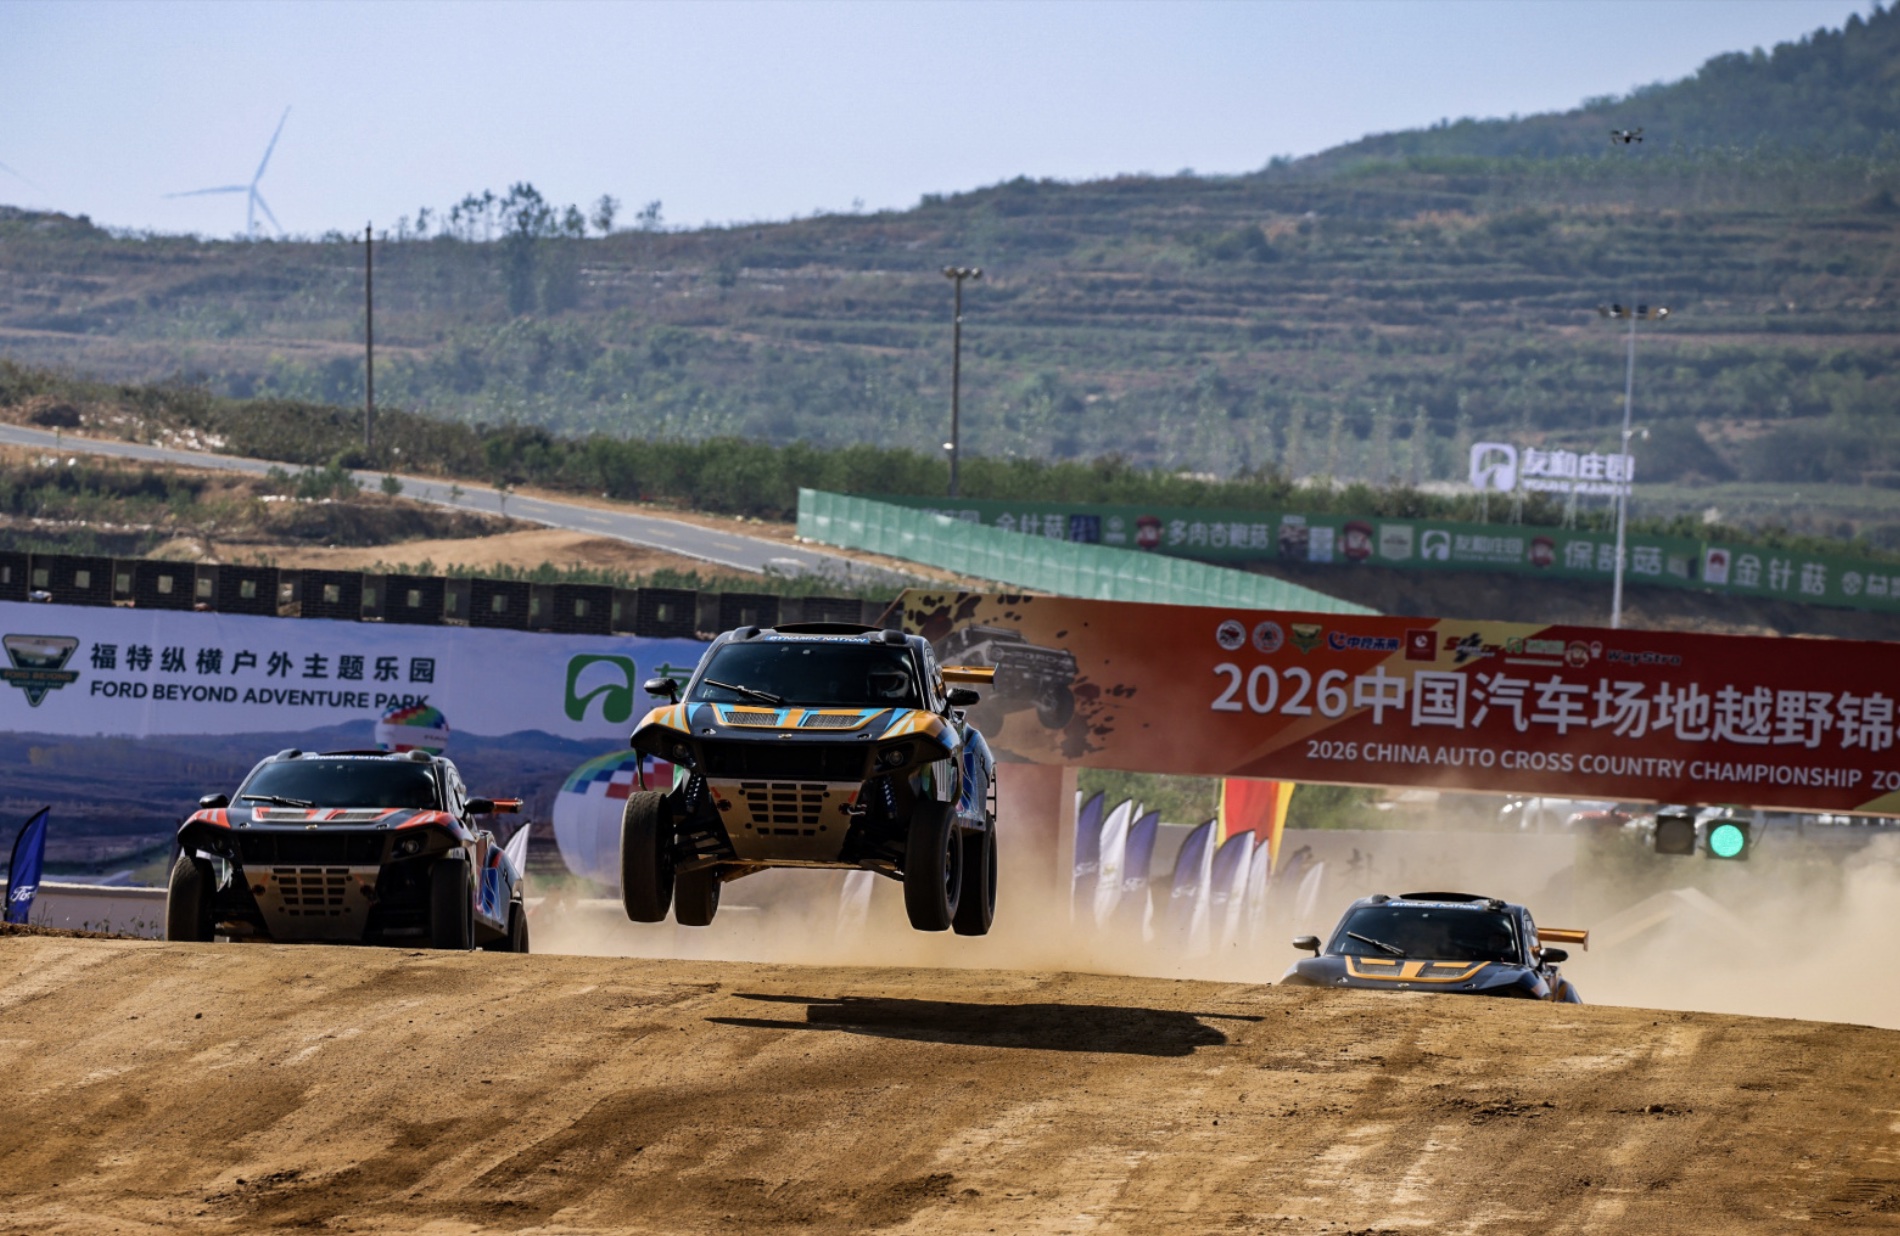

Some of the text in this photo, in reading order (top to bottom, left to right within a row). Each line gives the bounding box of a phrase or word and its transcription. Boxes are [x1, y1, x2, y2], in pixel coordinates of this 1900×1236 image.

[1734, 554, 1827, 596] 金针菇
[90, 643, 436, 684] 福特纵横户外主题乐园
[90, 680, 430, 710] FORD BEYOND ADVENTURE PARK
[1211, 663, 1900, 752] 2026中国汽车场地越野锦
[1306, 740, 1358, 761] 2026
[1362, 742, 1431, 764] CHINA
[1434, 746, 1496, 768] AUTO
[1500, 750, 1574, 772] CROSS
[1579, 755, 1685, 778] COUNTRY
[1690, 760, 1862, 788] CHAMPIONSHIP
